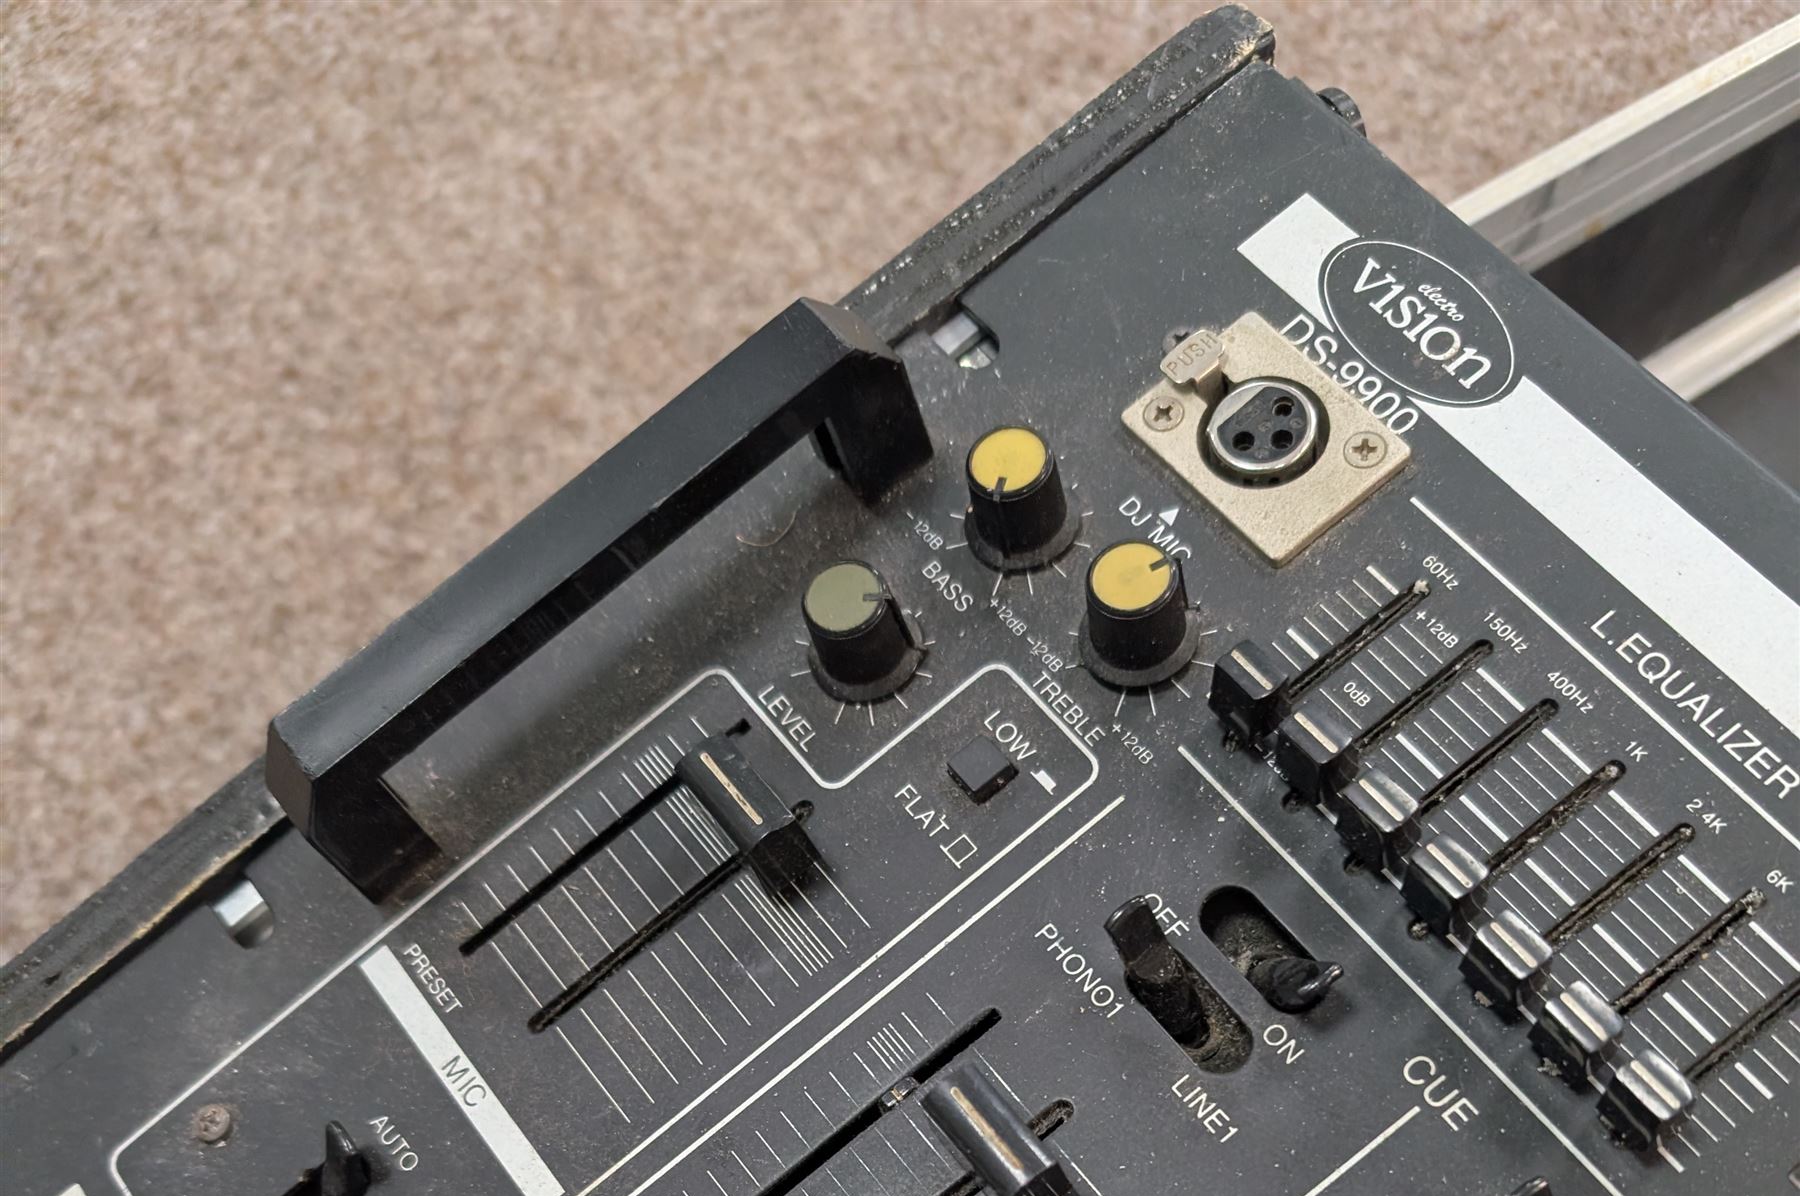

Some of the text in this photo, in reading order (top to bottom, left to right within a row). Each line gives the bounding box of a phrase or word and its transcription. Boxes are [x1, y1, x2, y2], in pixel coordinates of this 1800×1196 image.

[1418, 284, 1464, 321] electro
[1166, 333, 1217, 376] PUSH
[1279, 314, 1418, 434] DS-9900
[1119, 497, 1152, 526] DJ
[922, 561, 974, 612] BASS
[1423, 555, 1459, 590] 60Hz
[990, 599, 1027, 636] +12dB
[1416, 610, 1459, 649] +12dB
[1483, 612, 1528, 654] 150Hz
[1032, 671, 1106, 747] TREBLE
[1343, 681, 1371, 707] 0dB
[1546, 668, 1594, 715] 400Hz
[1590, 610, 1800, 799] L.EQUALIZER
[757, 685, 816, 753] LEVEL
[984, 710, 1037, 761] LOW
[1112, 723, 1154, 765] +12dB
[1625, 740, 1649, 763] 1K
[894, 784, 950, 838] FLAT
[1766, 869, 1794, 894] 6K
[1144, 893, 1190, 936] OFF
[403, 944, 463, 1014] PRESET
[1035, 922, 1126, 1019] PHONO1
[1263, 1023, 1305, 1066] ON
[441, 1055, 487, 1108] MIC
[1403, 1055, 1479, 1132] CUE
[1171, 1073, 1239, 1144] LINE1
[370, 1115, 419, 1173] AUTO
